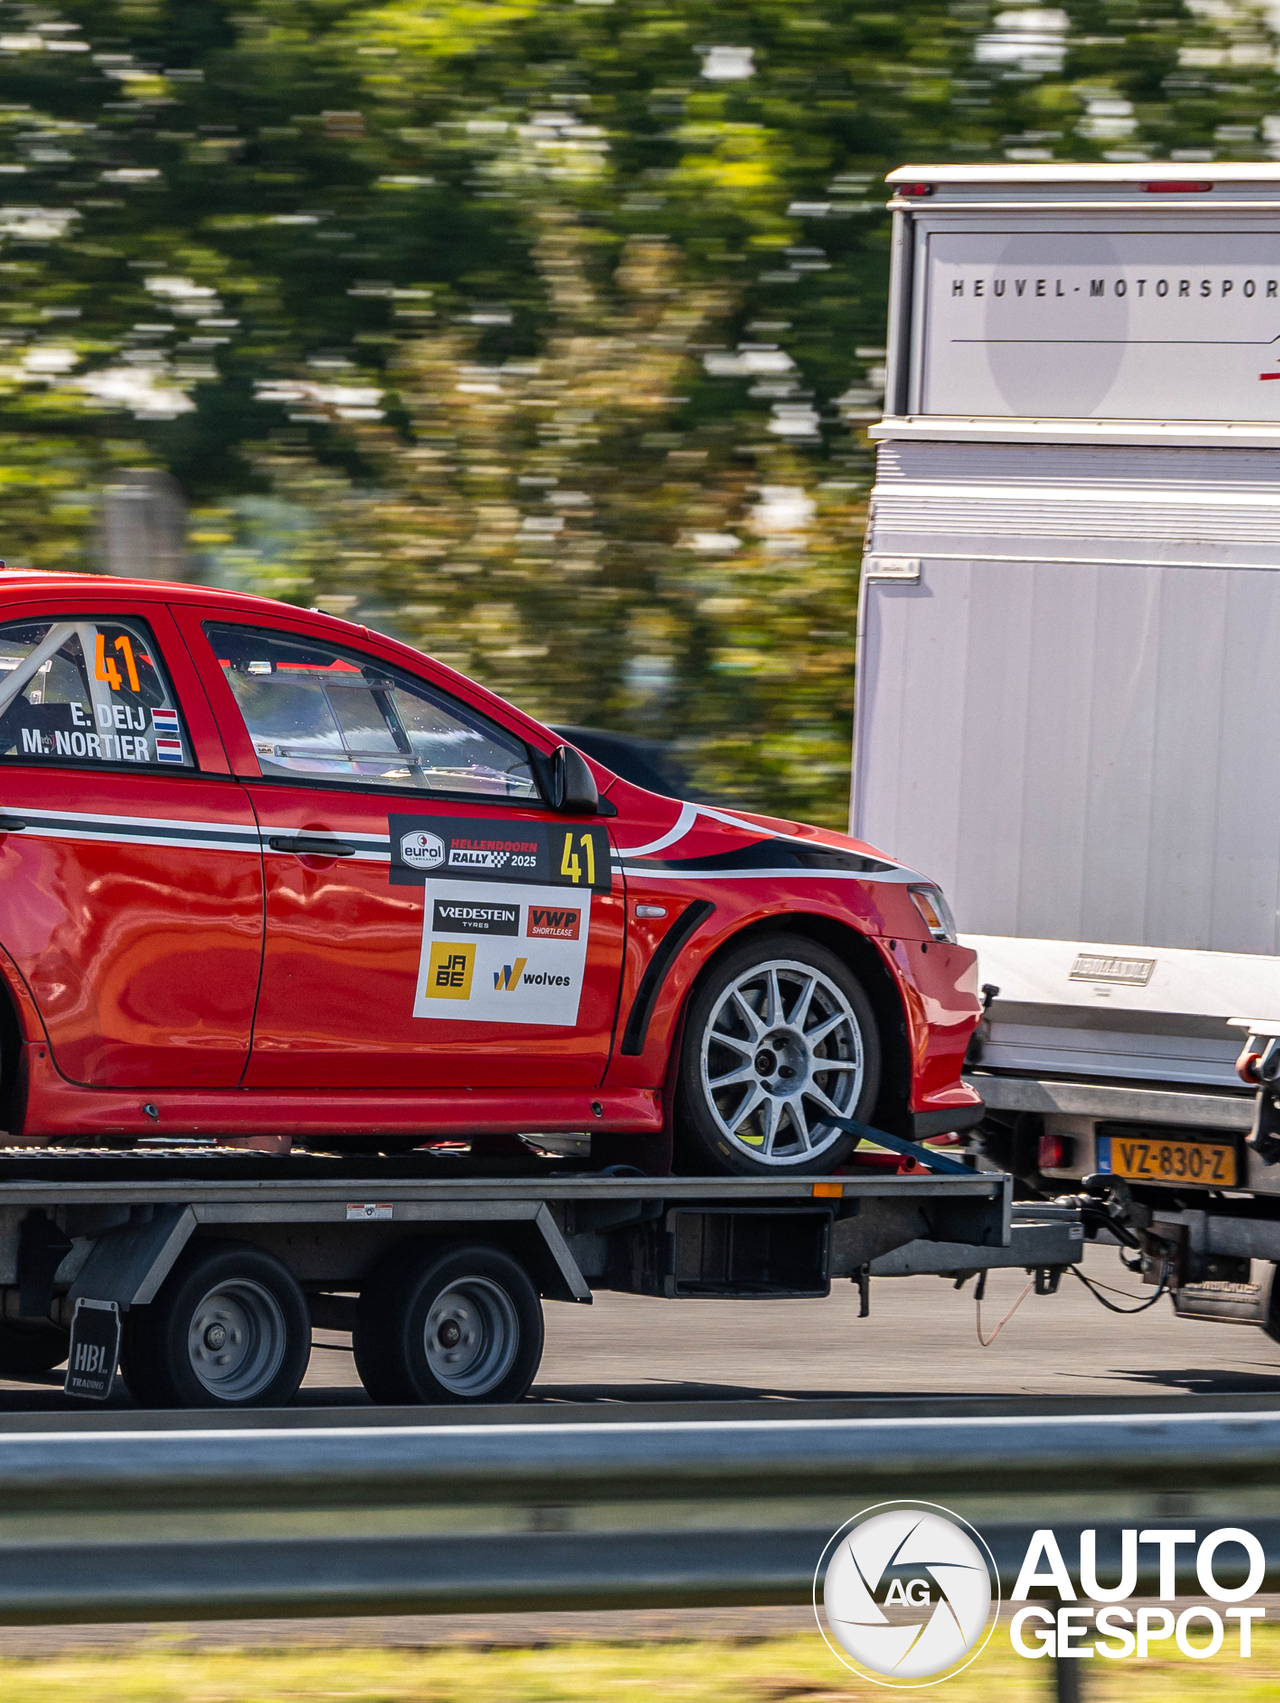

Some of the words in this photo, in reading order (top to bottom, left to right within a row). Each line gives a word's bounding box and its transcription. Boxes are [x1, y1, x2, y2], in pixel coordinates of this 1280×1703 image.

[94, 634, 141, 692] 41
[70, 702, 92, 727] E.
[96, 703, 146, 731] DEIJ
[21, 728, 49, 754] M.
[54, 730, 151, 761] NORTIER
[404, 845, 442, 859] eurol
[450, 838, 538, 853] HELLENDOORN
[451, 852, 490, 865] RALLY
[510, 855, 537, 868] 2025
[560, 832, 596, 884] 41
[438, 906, 516, 922] VREDESTEIN
[532, 910, 577, 928] VWP
[462, 921, 490, 929] TYRES
[531, 926, 574, 937] SHORTLEASE
[437, 954, 467, 971] JA
[435, 970, 465, 987] BE
[523, 971, 571, 987] wolves
[1119, 1143, 1225, 1179] VZ-830-Z
[72, 1377, 105, 1391] TRADING
